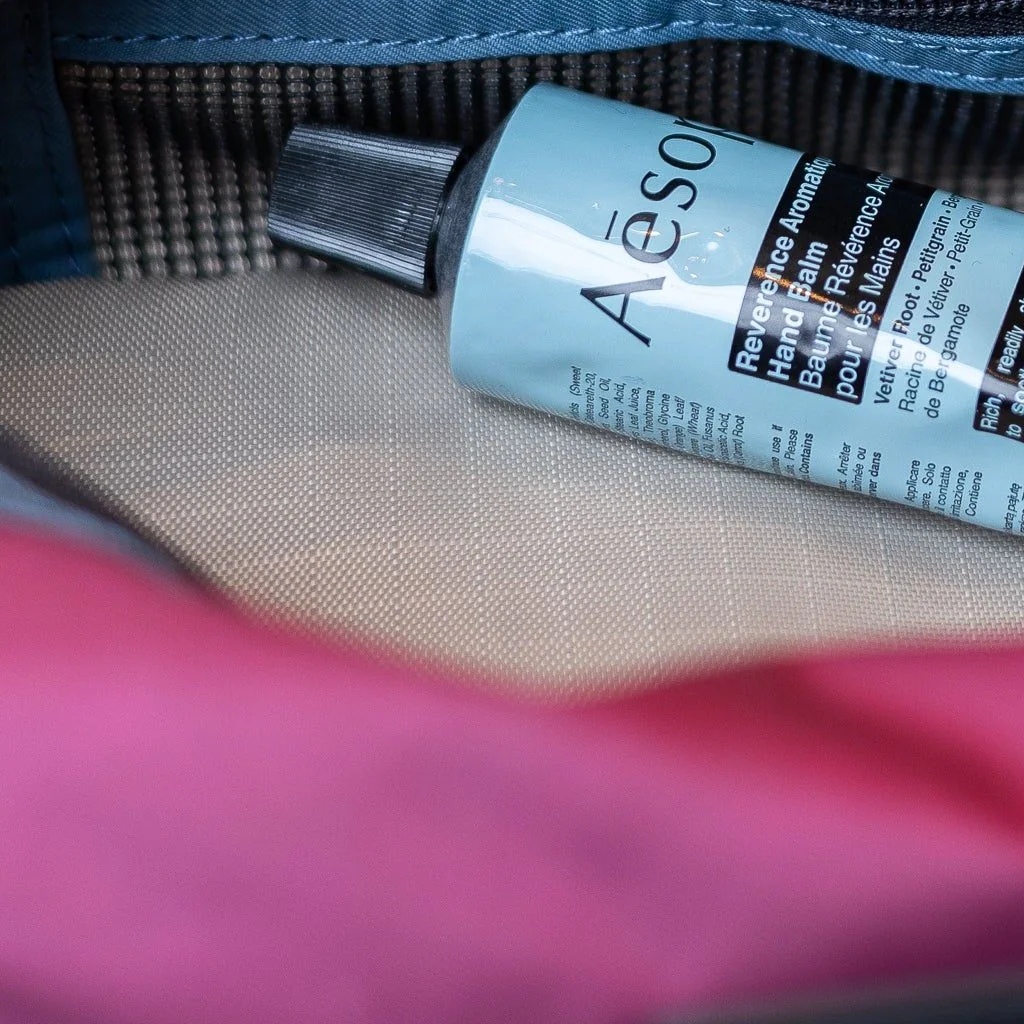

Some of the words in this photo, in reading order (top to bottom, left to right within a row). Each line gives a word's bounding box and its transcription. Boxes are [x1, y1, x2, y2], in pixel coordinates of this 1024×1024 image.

[946, 205, 983, 262] Petit-Grain
[859, 237, 900, 295] Mains
[735, 236, 794, 371] Reverence
[799, 297, 842, 389] Baume
[824, 196, 882, 295] Révérence
[874, 340, 902, 403] Vetiver
[892, 293, 920, 335] Root
[911, 216, 951, 282] Petitgrain
[923, 271, 955, 318] Vétiver
[767, 308, 804, 380] Hand
[788, 242, 828, 301] Balm
[847, 300, 876, 333] les
[917, 324, 935, 345] de
[928, 304, 970, 393] Bergamote
[570, 365, 583, 397] (Sweet
[598, 377, 612, 392] Oil,
[837, 340, 862, 399] pour
[898, 351, 926, 412] Racine
[598, 396, 610, 420] Seed
[613, 382, 628, 404] Acid,
[629, 386, 642, 412] Juice,
[657, 393, 671, 426] Glycine
[924, 398, 941, 418] de
[627, 412, 639, 430] Leaf
[642, 389, 656, 433] Theobroma
[686, 401, 702, 436] (Wheat)
[701, 406, 716, 443] Fusanus
[717, 412, 731, 435] Acid,
[731, 414, 746, 438] Root
[771, 423, 784, 432] if
[980, 394, 1005, 430] Rich,
[771, 436, 782, 454] use
[783, 428, 799, 461] Please
[1006, 424, 1022, 437] to
[798, 432, 814, 475] Contains
[836, 441, 852, 477] Arrêter
[856, 446, 867, 461] ou
[868, 451, 882, 478] dans
[903, 459, 921, 503] Applicare
[921, 462, 937, 486] Solo
[937, 465, 952, 506] contatto
[964, 471, 983, 517] Contiene
